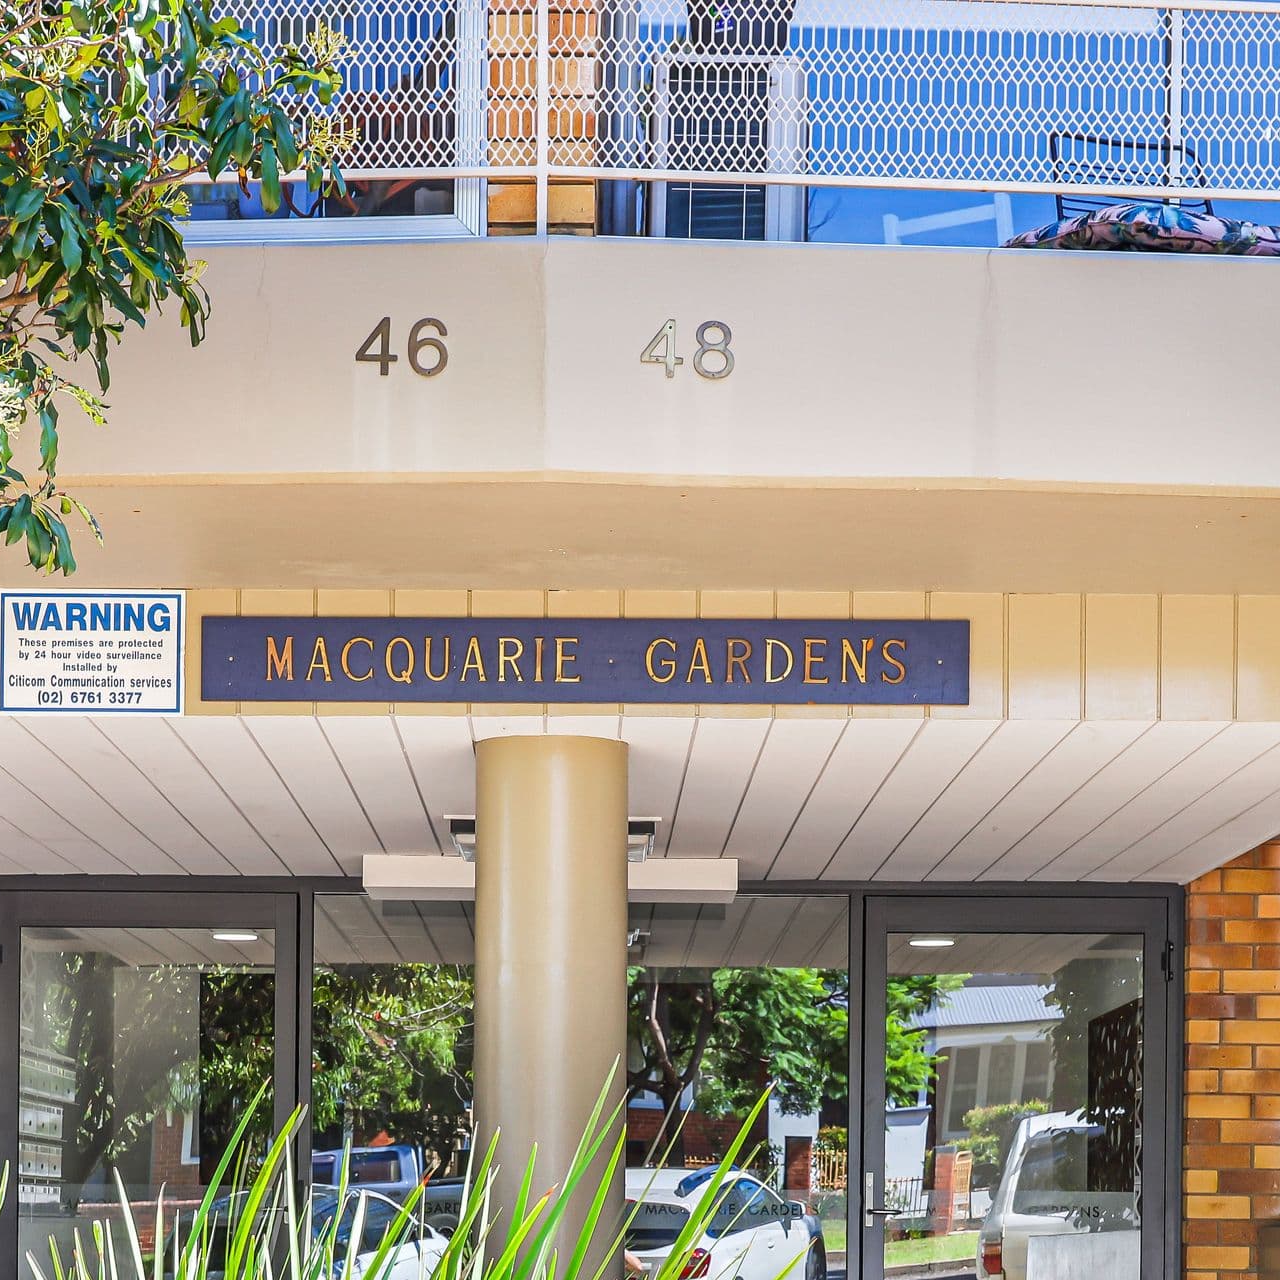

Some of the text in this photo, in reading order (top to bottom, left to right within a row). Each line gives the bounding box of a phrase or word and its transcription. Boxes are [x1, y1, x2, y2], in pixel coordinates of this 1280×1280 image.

[355, 316, 449, 377] 46
[640, 318, 735, 379] 48
[11, 602, 171, 632] WARNING
[18, 638, 163, 649] These premises are protected
[18, 650, 162, 660] by 24 hour video surveillance
[265, 636, 582, 684] MACQUARIE
[62, 663, 118, 673] Installed by
[8, 675, 172, 688] Citicom Communication services
[37, 690, 142, 705] (02) 6761 3377
